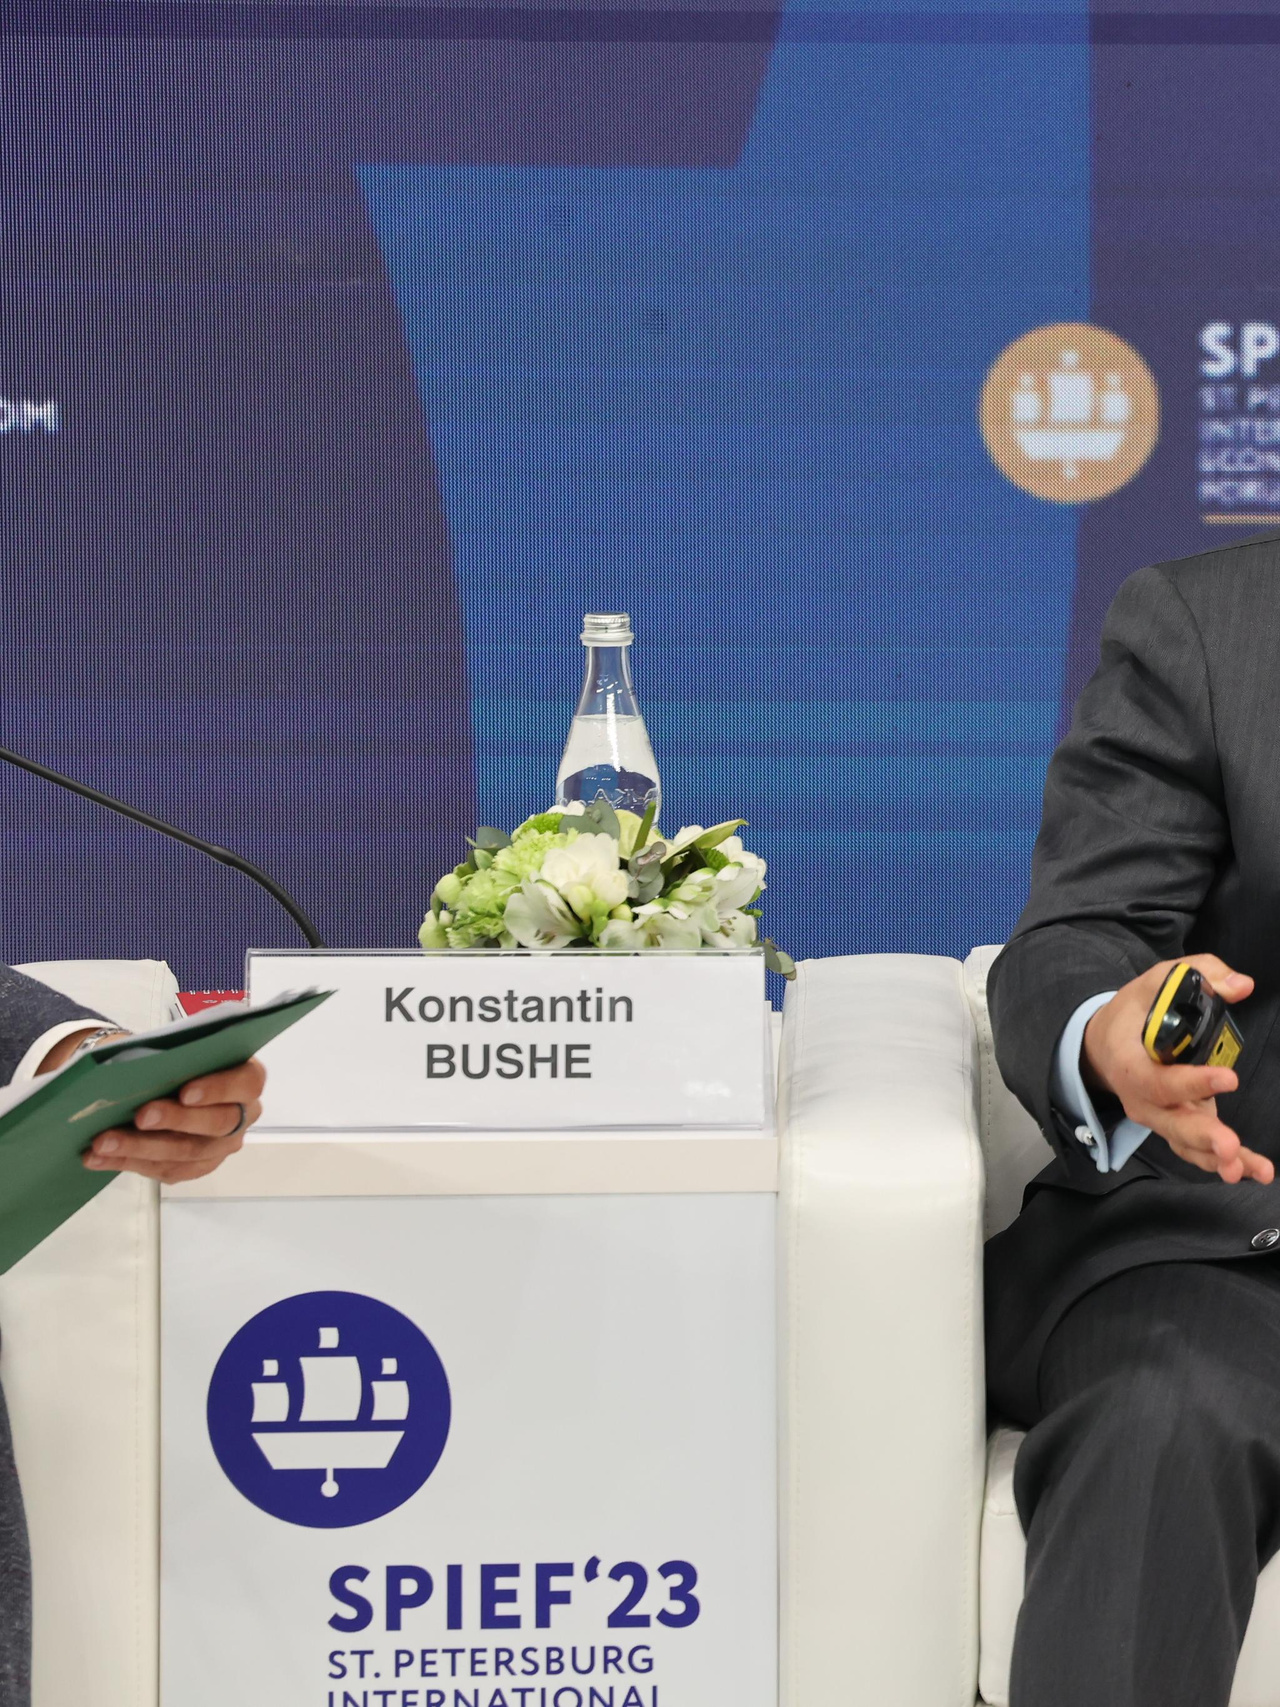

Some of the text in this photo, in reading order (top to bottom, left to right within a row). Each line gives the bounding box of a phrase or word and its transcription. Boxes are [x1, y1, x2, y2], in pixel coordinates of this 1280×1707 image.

[385, 987, 633, 1023] Konstantin
[426, 1043, 592, 1080] BUSHE
[328, 1645, 654, 1679] ST. PETERSBURG
